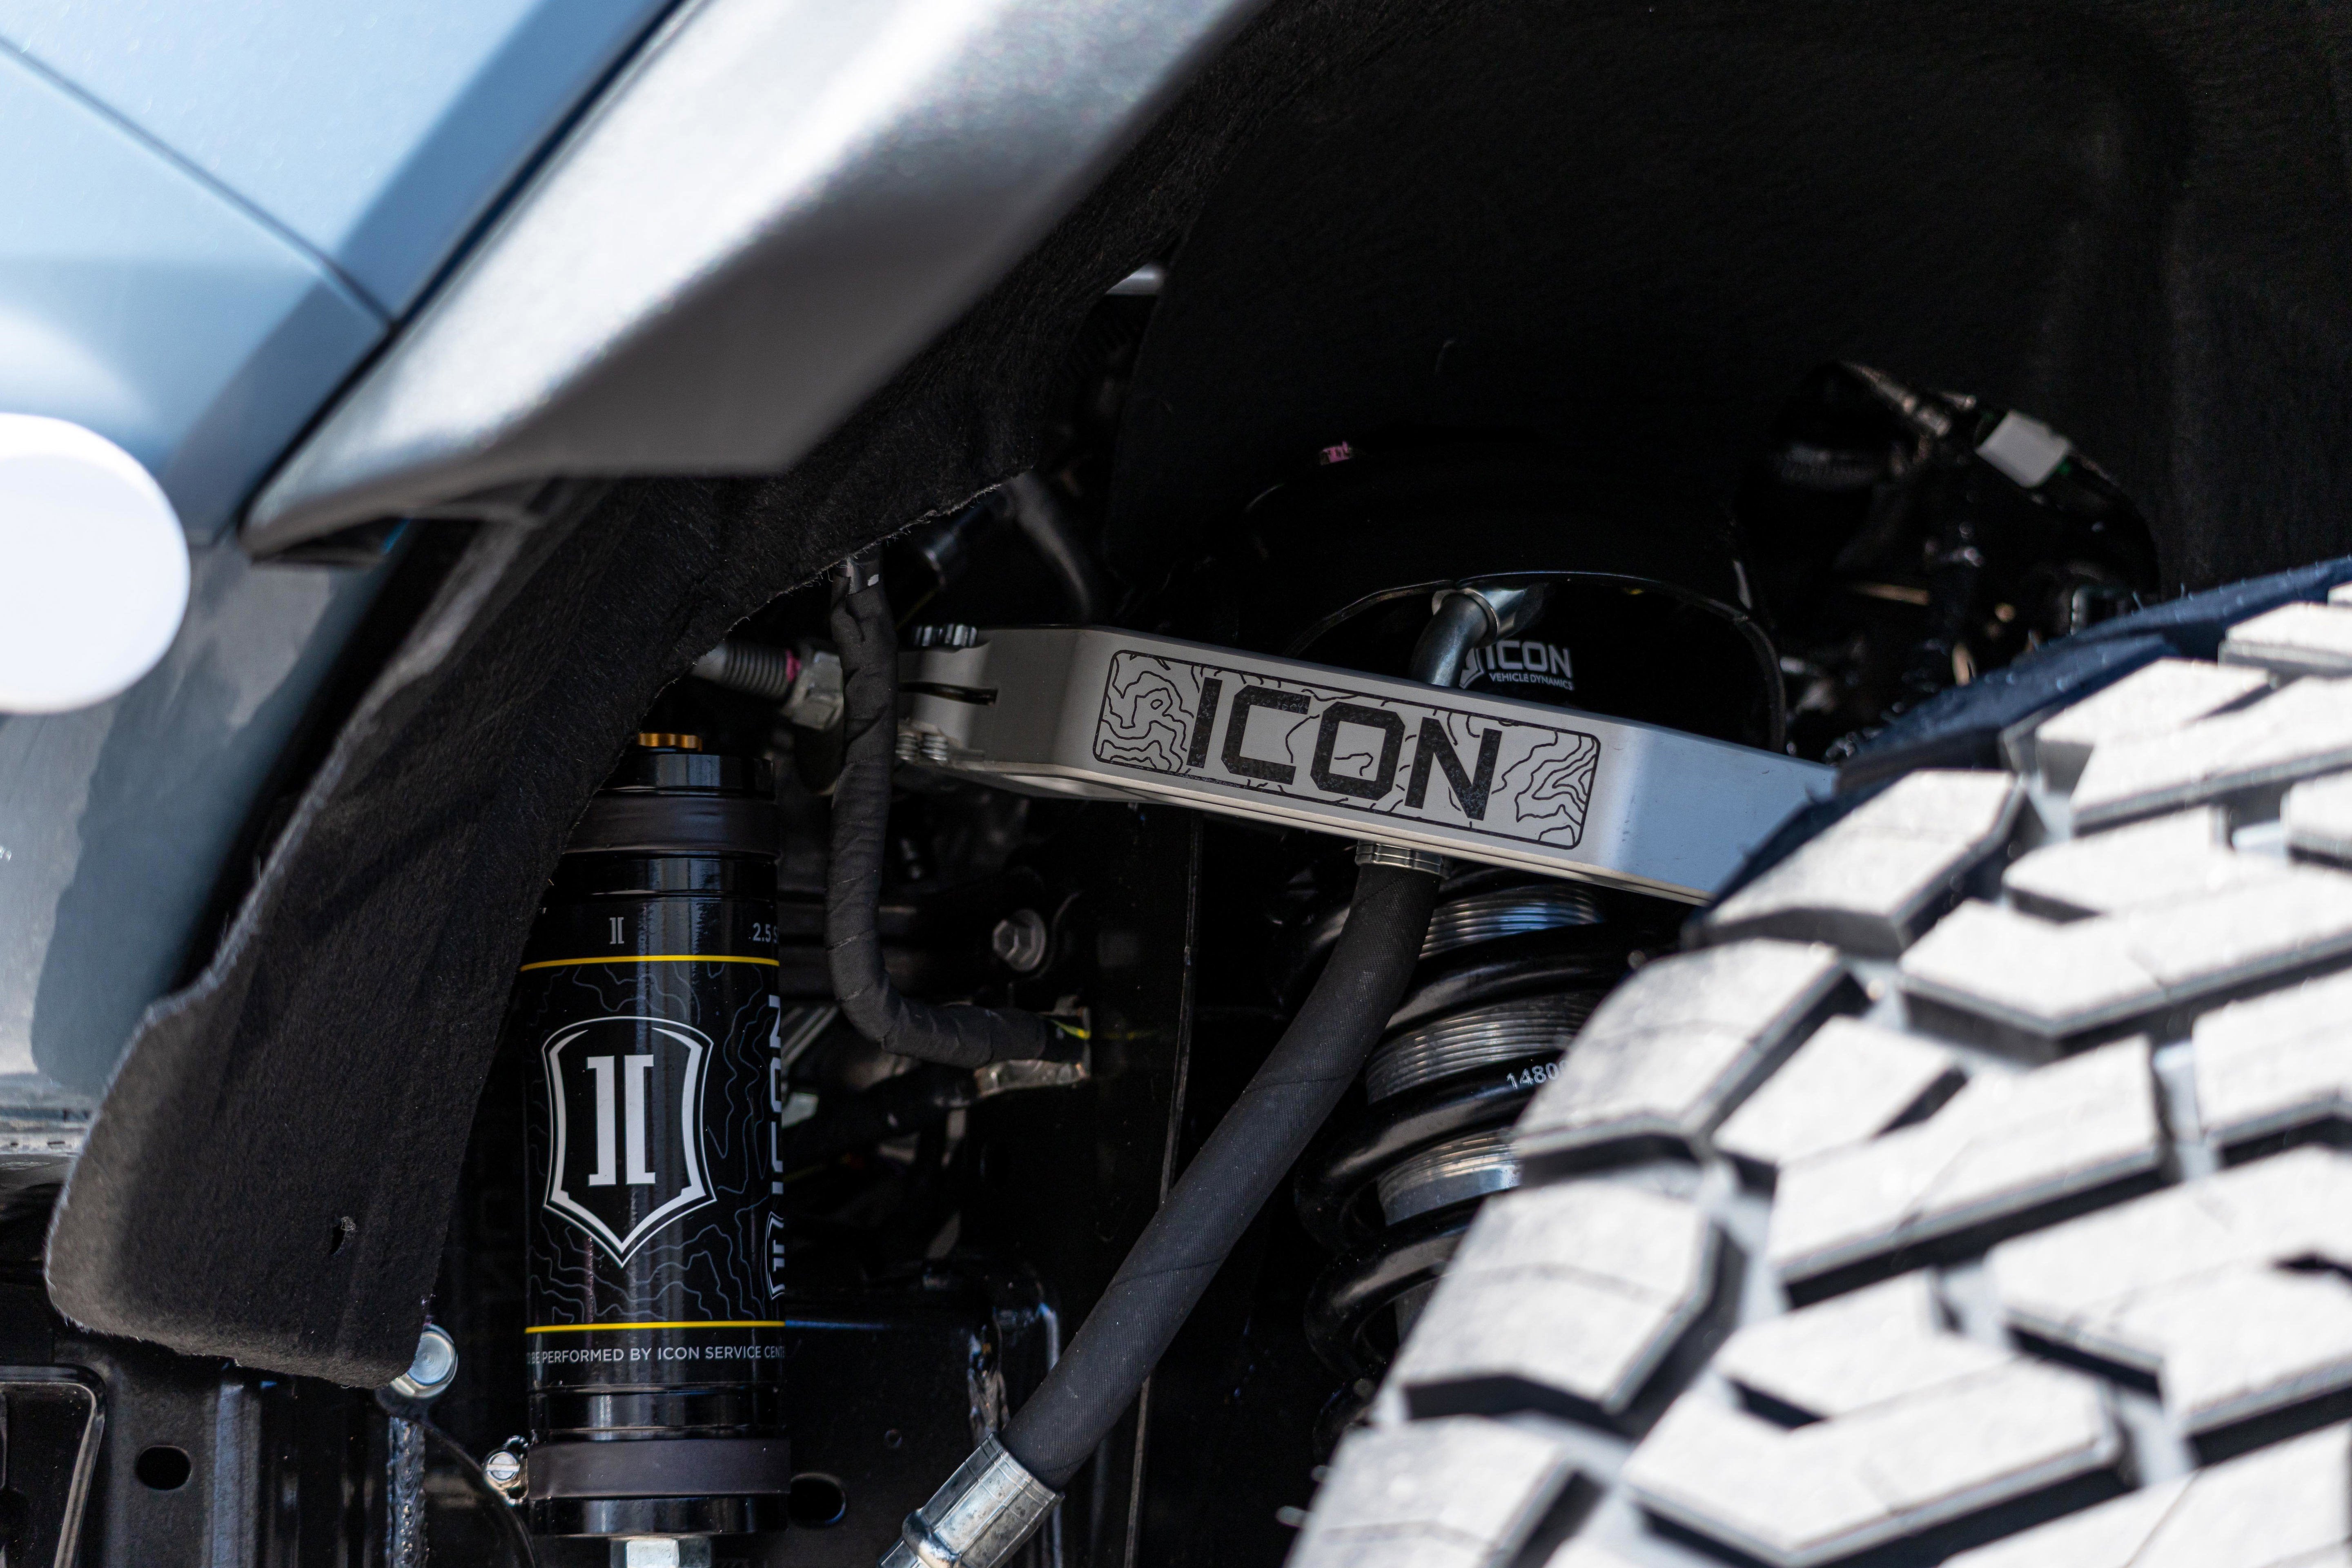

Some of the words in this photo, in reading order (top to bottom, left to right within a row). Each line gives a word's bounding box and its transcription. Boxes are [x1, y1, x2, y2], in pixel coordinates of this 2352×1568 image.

[1485, 640, 1572, 679] ICON
[1489, 673, 1529, 683] VEHICLE
[1530, 674, 1575, 691] DYNAMICS
[1185, 677, 1502, 821] ICON
[753, 922, 771, 942] 2.5
[542, 1348, 624, 1363] PERFORMED
[630, 1347, 652, 1361] BY
[657, 1347, 699, 1361] ICON
[705, 1345, 762, 1360] SERVICE
